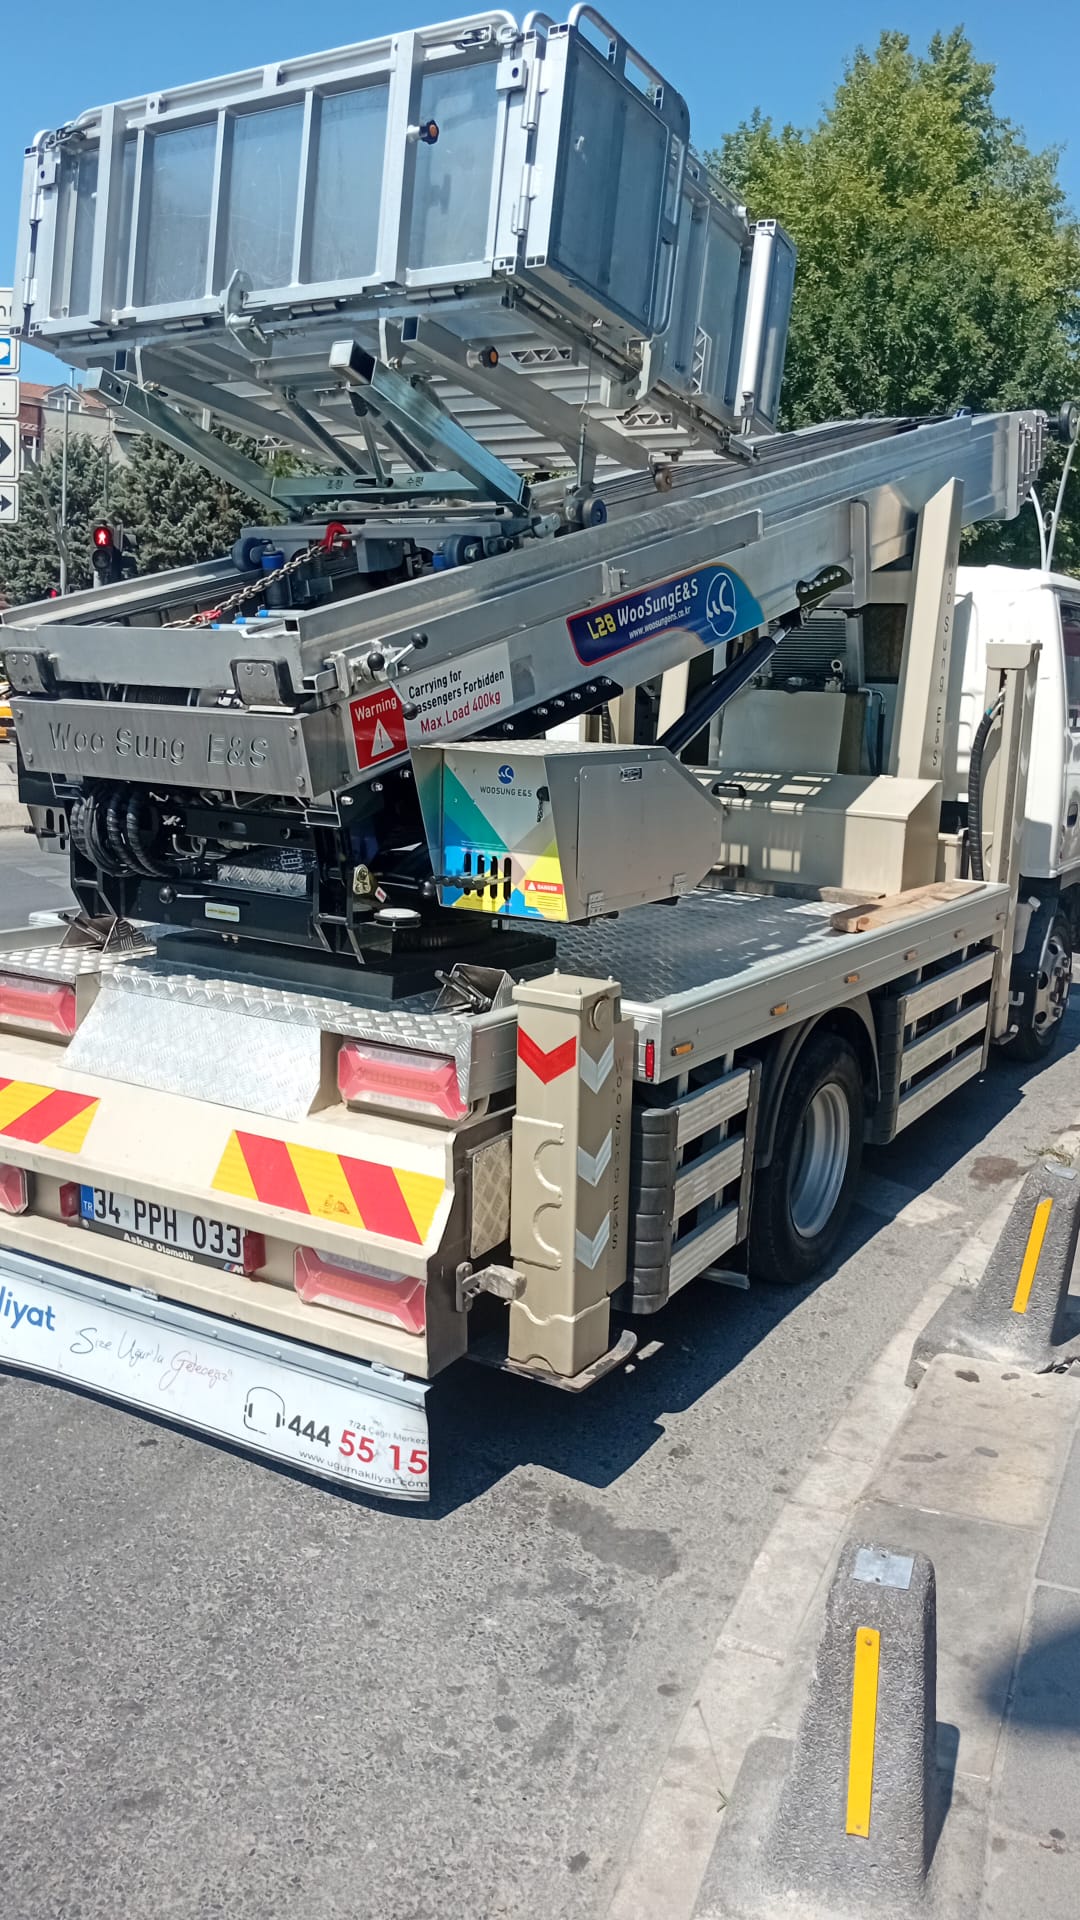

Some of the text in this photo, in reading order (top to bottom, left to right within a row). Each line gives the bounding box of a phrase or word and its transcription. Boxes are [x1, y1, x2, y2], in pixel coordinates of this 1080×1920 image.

[587, 578, 699, 640] L28 WooSungE&S
[408, 670, 462, 699] Carrying for
[416, 670, 505, 714] assengers Forbidden
[354, 696, 397, 722] Warning
[472, 690, 501, 713] 400kg
[48, 722, 269, 767] Woo Sung E&S
[480, 786, 533, 797] WOOSUNG E&S
[83, 1200, 93, 1212] TR
[94, 1188, 241, 1258] 34 PPH 033
[123, 1232, 194, 1262] Askar Otomotiv
[288, 1414, 428, 1475] 444 55 15
